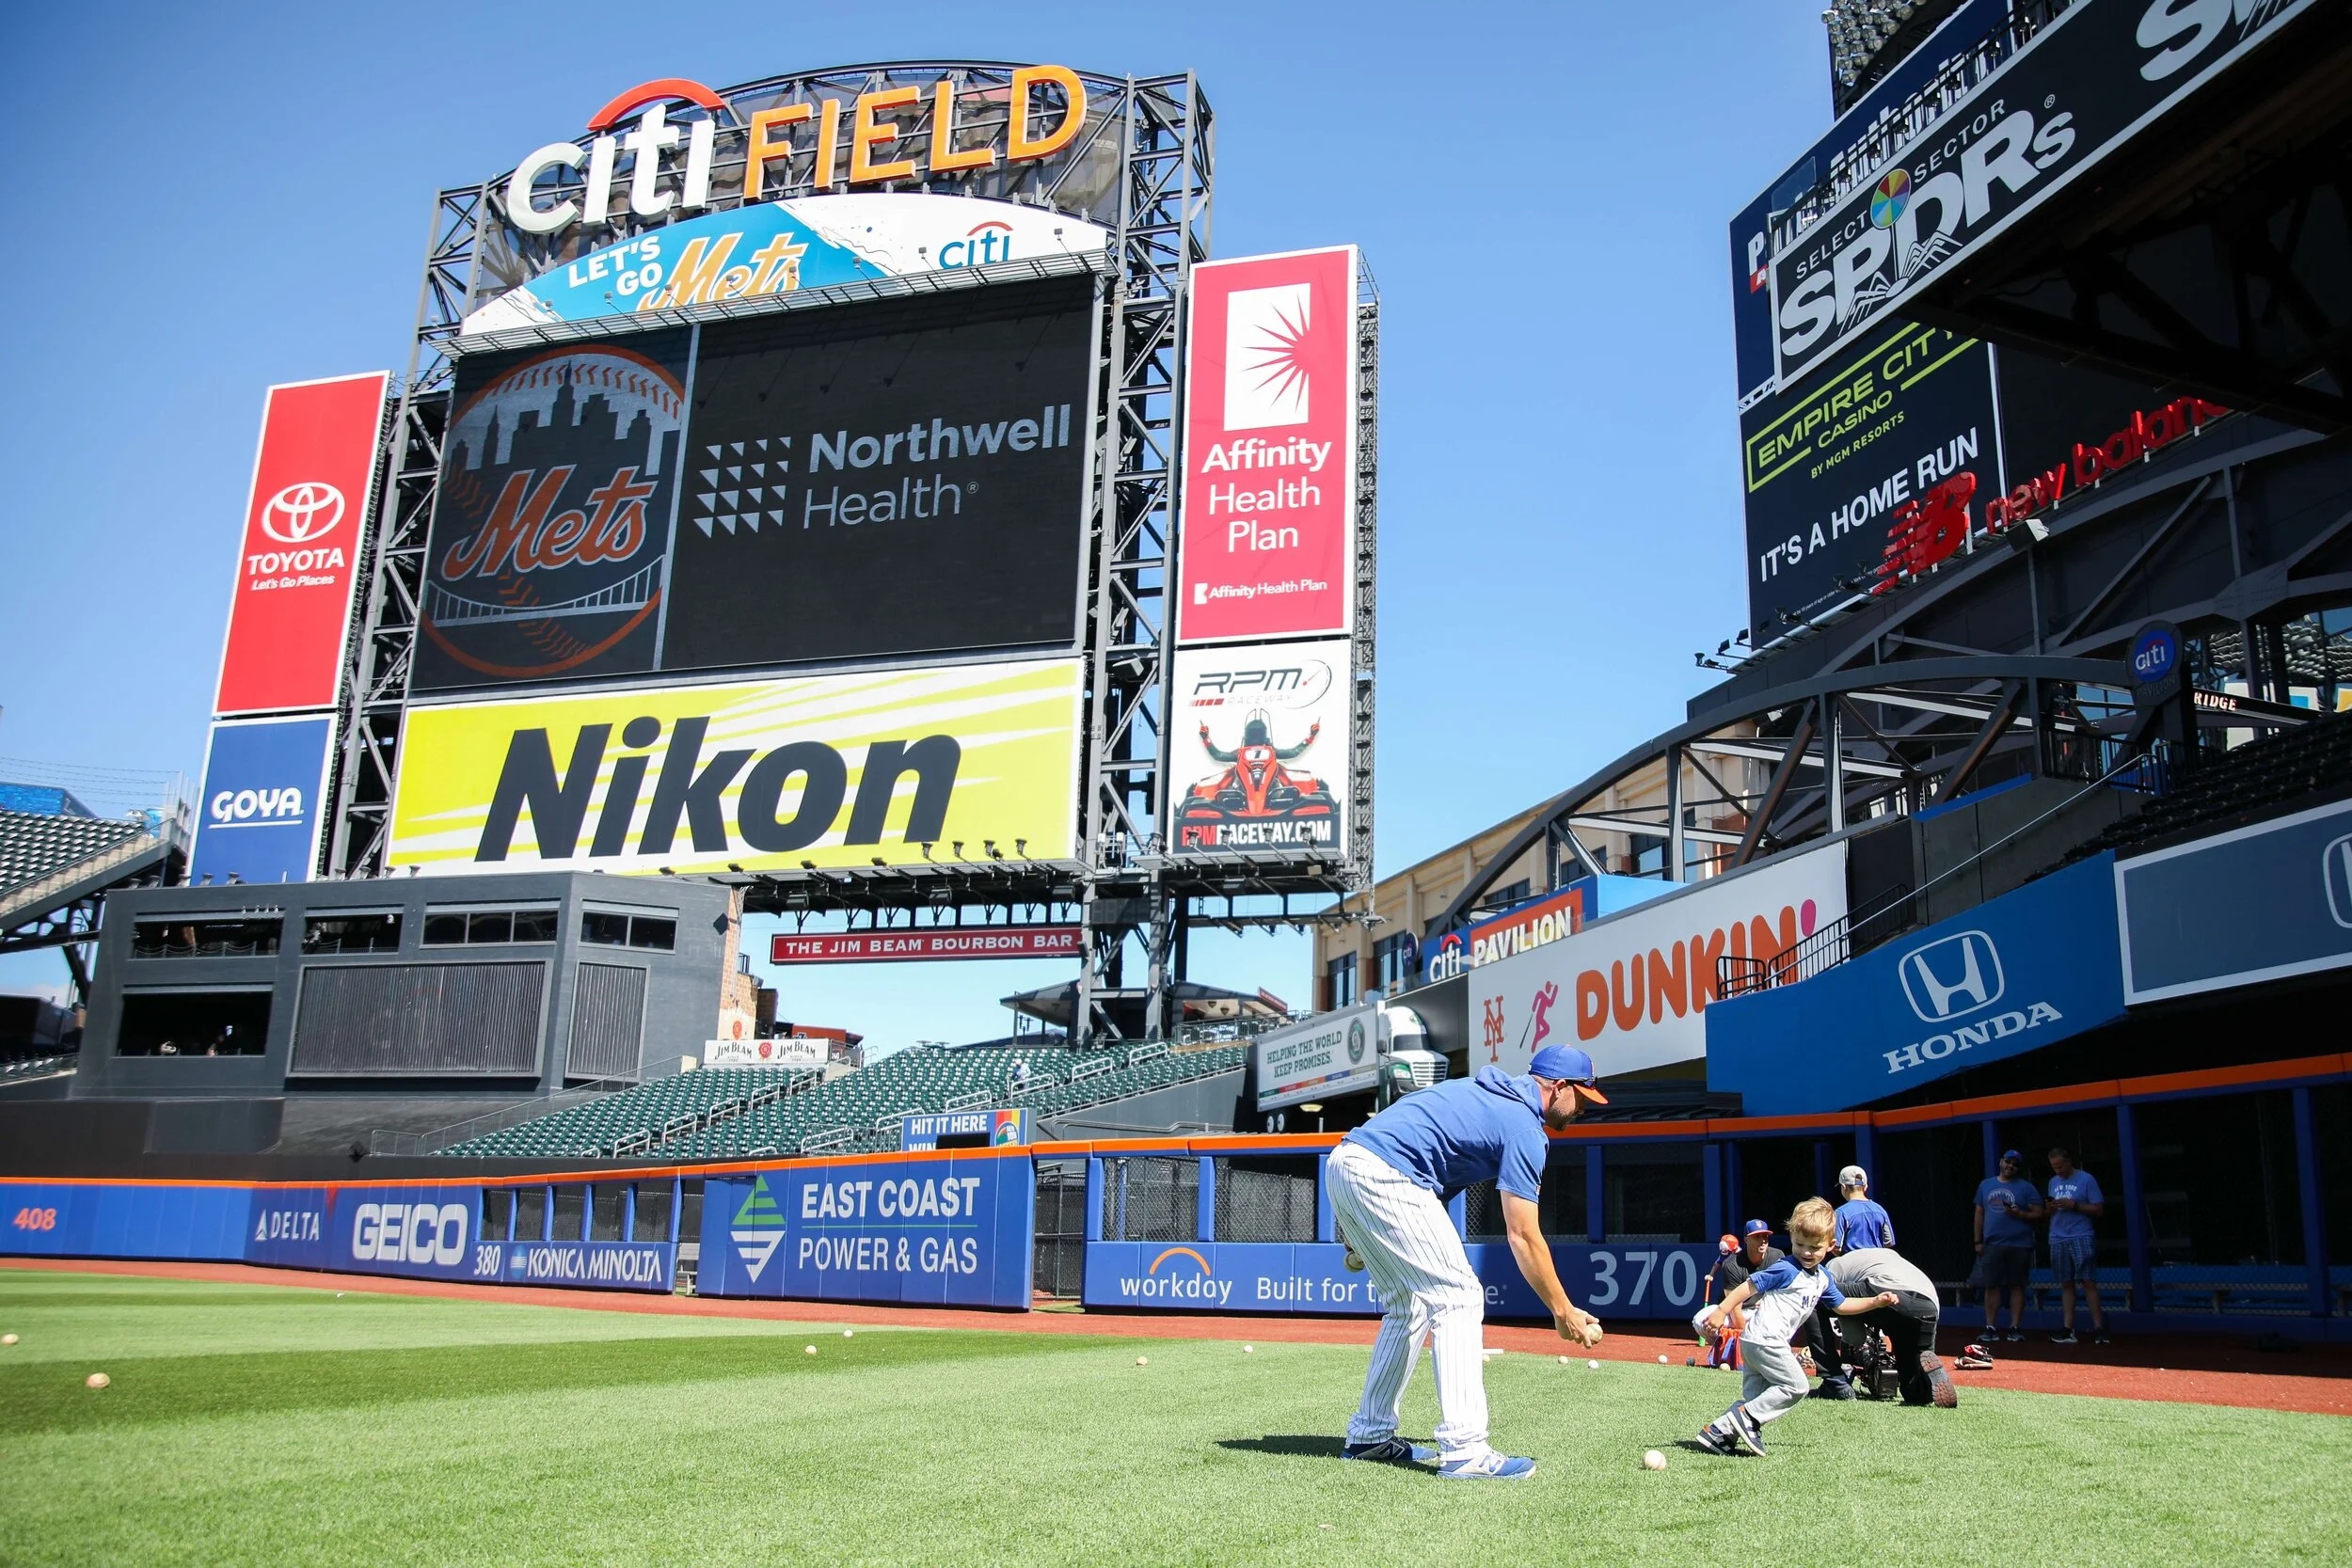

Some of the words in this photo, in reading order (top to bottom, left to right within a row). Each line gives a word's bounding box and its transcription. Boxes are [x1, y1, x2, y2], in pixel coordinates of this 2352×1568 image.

[506, 94, 724, 234] citi
[742, 65, 1088, 201] FIELD
[1796, 210, 1867, 279] SELECT
[1914, 99, 2006, 183] SECTOR
[568, 235, 660, 289] LET'S
[939, 226, 1010, 270] citi
[616, 262, 662, 296] GO
[637, 231, 810, 313] Mets
[1758, 371, 1874, 468] EMPIRE
[1883, 327, 1953, 380] CIT
[1818, 390, 1893, 449] CASINO
[808, 404, 1072, 474] Northwell
[1200, 436, 1332, 473] Affinity
[1810, 462, 1824, 479] BY
[1826, 446, 1851, 469] MGM
[1852, 411, 1905, 452] RESORTS
[1985, 463, 2067, 534] new
[2073, 396, 2233, 487] balan
[803, 473, 961, 530] Health
[1209, 476, 1321, 515] Health
[1760, 533, 1803, 582] IT'S
[1808, 521, 1826, 556] A
[1832, 468, 1910, 540] HOME
[1917, 427, 1979, 489] RUN
[441, 465, 659, 581] Mets
[1228, 519, 1298, 553] Plan
[247, 546, 345, 576] TOYOTA
[251, 578, 278, 592] Let's
[279, 576, 296, 589] Go
[296, 575, 335, 587] Places
[1209, 584, 1256, 600] Affinity
[1257, 579, 1298, 594] Health
[1300, 578, 1327, 592] Plan
[2135, 642, 2166, 671] citi
[1193, 668, 1303, 695] RPM
[1227, 694, 1293, 705] RACEWAY
[212, 787, 301, 822] GOYA
[474, 715, 961, 863] Nikon
[787, 941, 823, 955] THE
[829, 941, 861, 954] JIM
[869, 939, 923, 952] BEAM
[931, 936, 1024, 950] BOURBON
[1033, 935, 1073, 947] BAR
[1430, 937, 1461, 983] citi
[1473, 906, 1571, 969] PAVILION
[1576, 899, 1817, 1041] DUNKIN'
[715, 1044, 729, 1060] JIM
[731, 1041, 752, 1058] BEAM
[777, 1043, 792, 1060] JIM
[794, 1040, 816, 1058] BEAM
[1266, 1044, 1297, 1064] HELPING
[1299, 1039, 1313, 1054] THE
[1315, 1030, 1343, 1050] WORLD
[1883, 1001, 2063, 1074] HONDA
[1274, 1061, 1293, 1078] KEEP
[911, 1117, 933, 1135] HIT
[936, 1117, 949, 1133] IT
[951, 1115, 988, 1132] HERE
[801, 1177, 873, 1220] EAST
[878, 1177, 981, 1219] COAST
[14, 1207, 57, 1231] 408
[270, 1211, 320, 1242] DELTA
[352, 1202, 469, 1267] GEICO
[473, 1245, 501, 1276] 380
[527, 1248, 585, 1280] KONICA
[587, 1248, 662, 1282] MINOLTA
[799, 1237, 888, 1271] POWER
[896, 1237, 911, 1271] &
[920, 1237, 979, 1275] GAS
[1120, 1272, 1232, 1306] workday
[1257, 1276, 1313, 1302] Built
[1321, 1277, 1358, 1303] for
[1588, 1251, 1694, 1307] 370
[1802, 1295, 1818, 1308] ME
